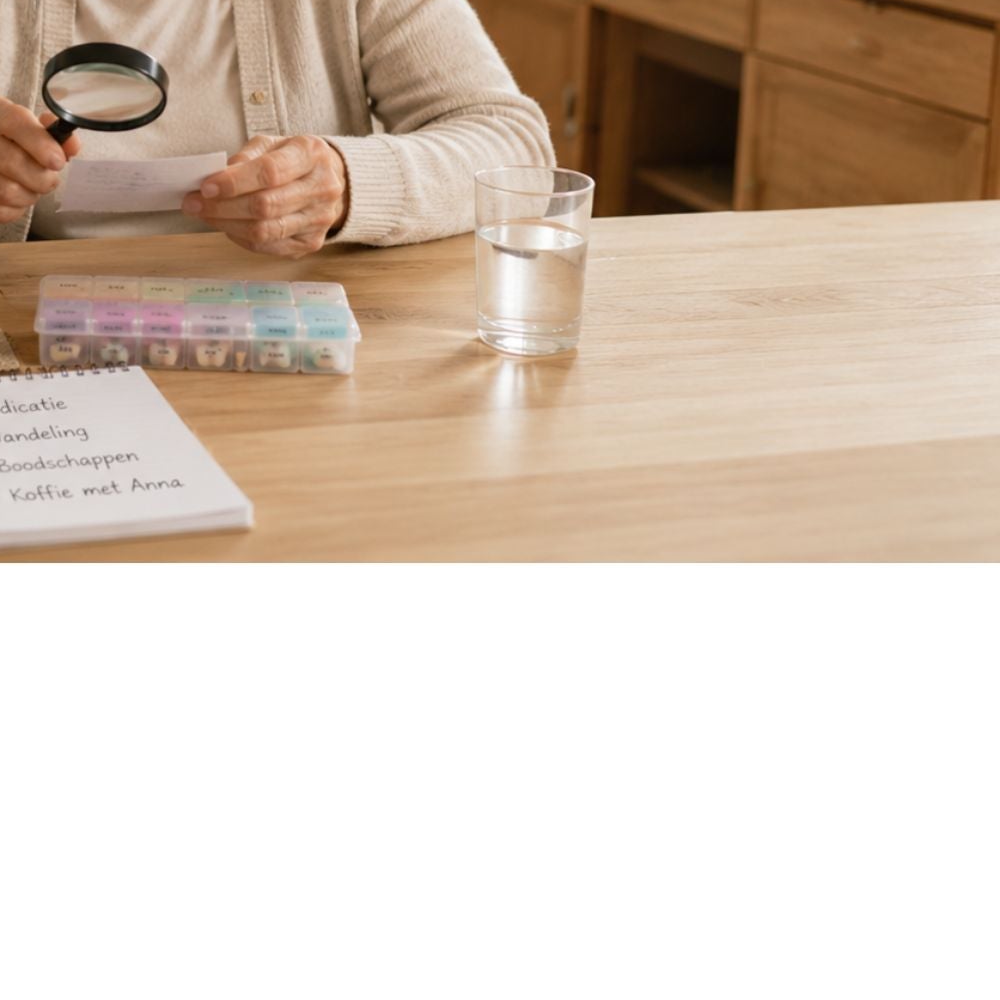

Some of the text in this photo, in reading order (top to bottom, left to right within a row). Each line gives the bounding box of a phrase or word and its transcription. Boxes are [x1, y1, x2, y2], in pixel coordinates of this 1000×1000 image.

[9, 475, 185, 502] Koffie met Anna
